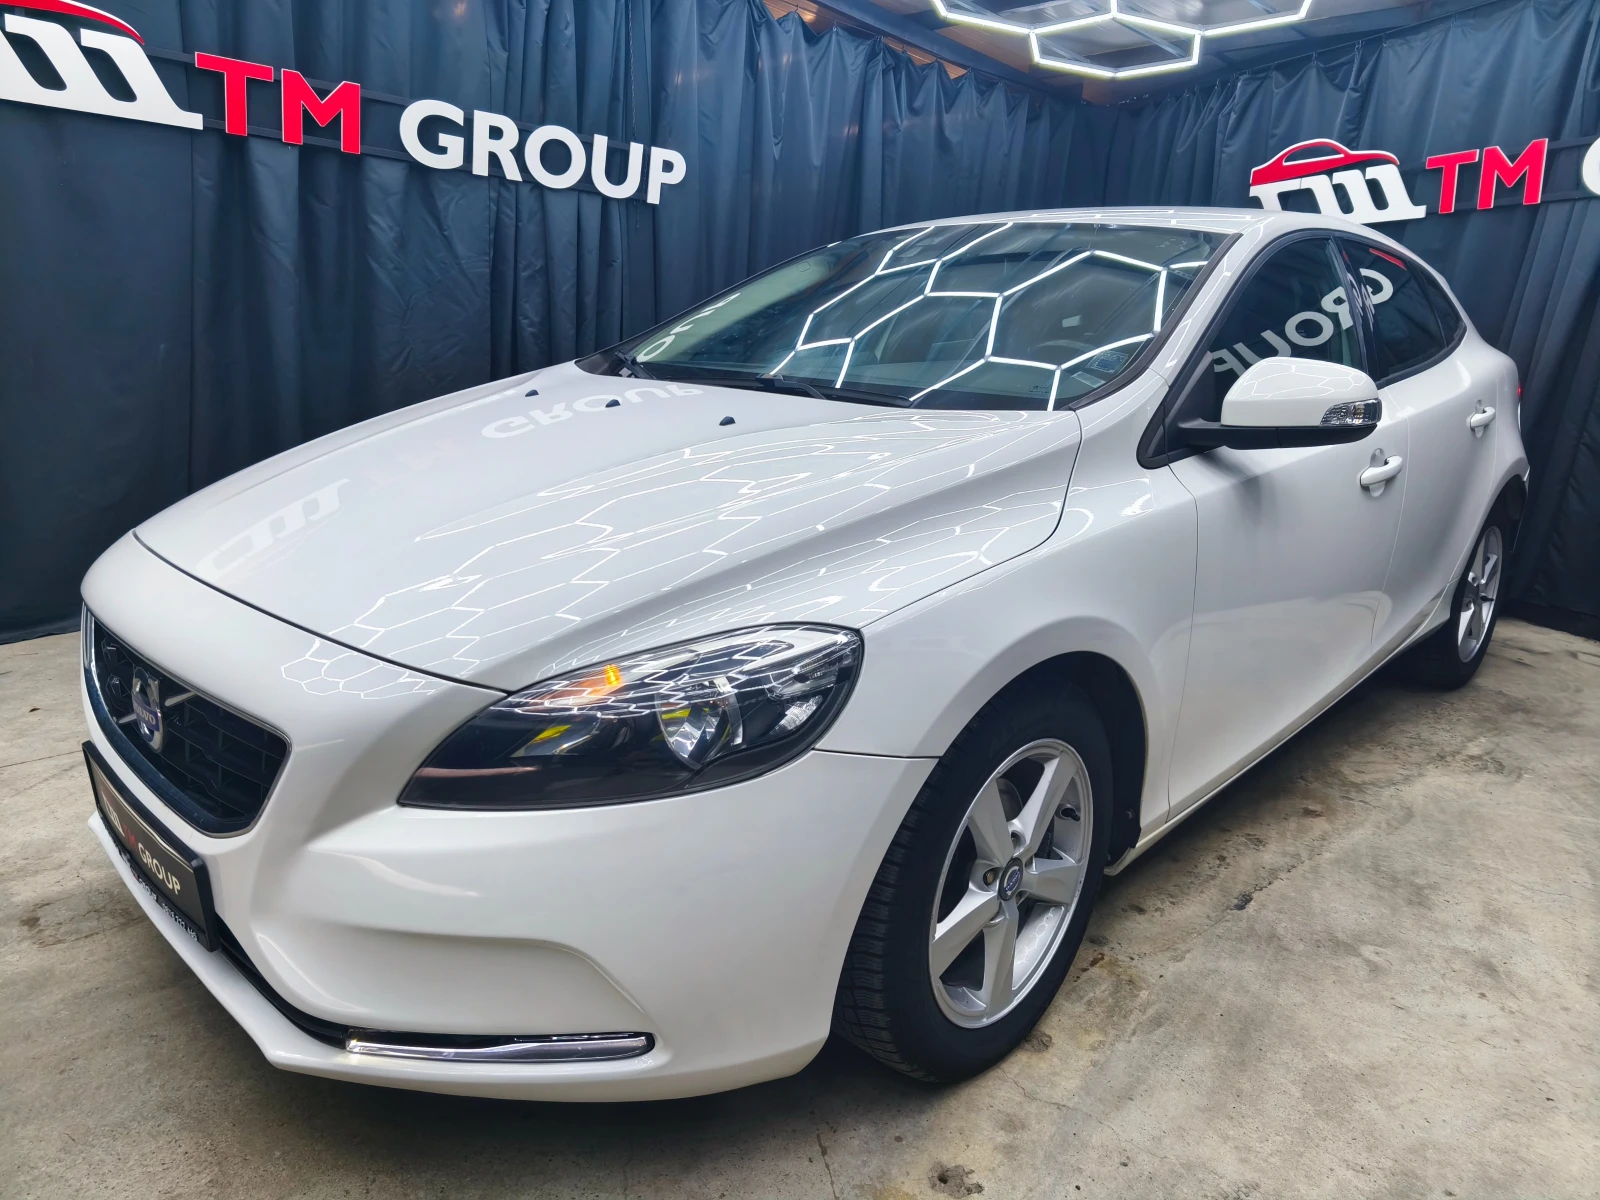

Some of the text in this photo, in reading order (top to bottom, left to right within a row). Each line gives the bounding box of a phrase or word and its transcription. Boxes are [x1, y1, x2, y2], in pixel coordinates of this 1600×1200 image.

[195, 52, 687, 205] TM GROUP
[1426, 138, 1549, 214] TM
[138, 842, 180, 895] GROUP
